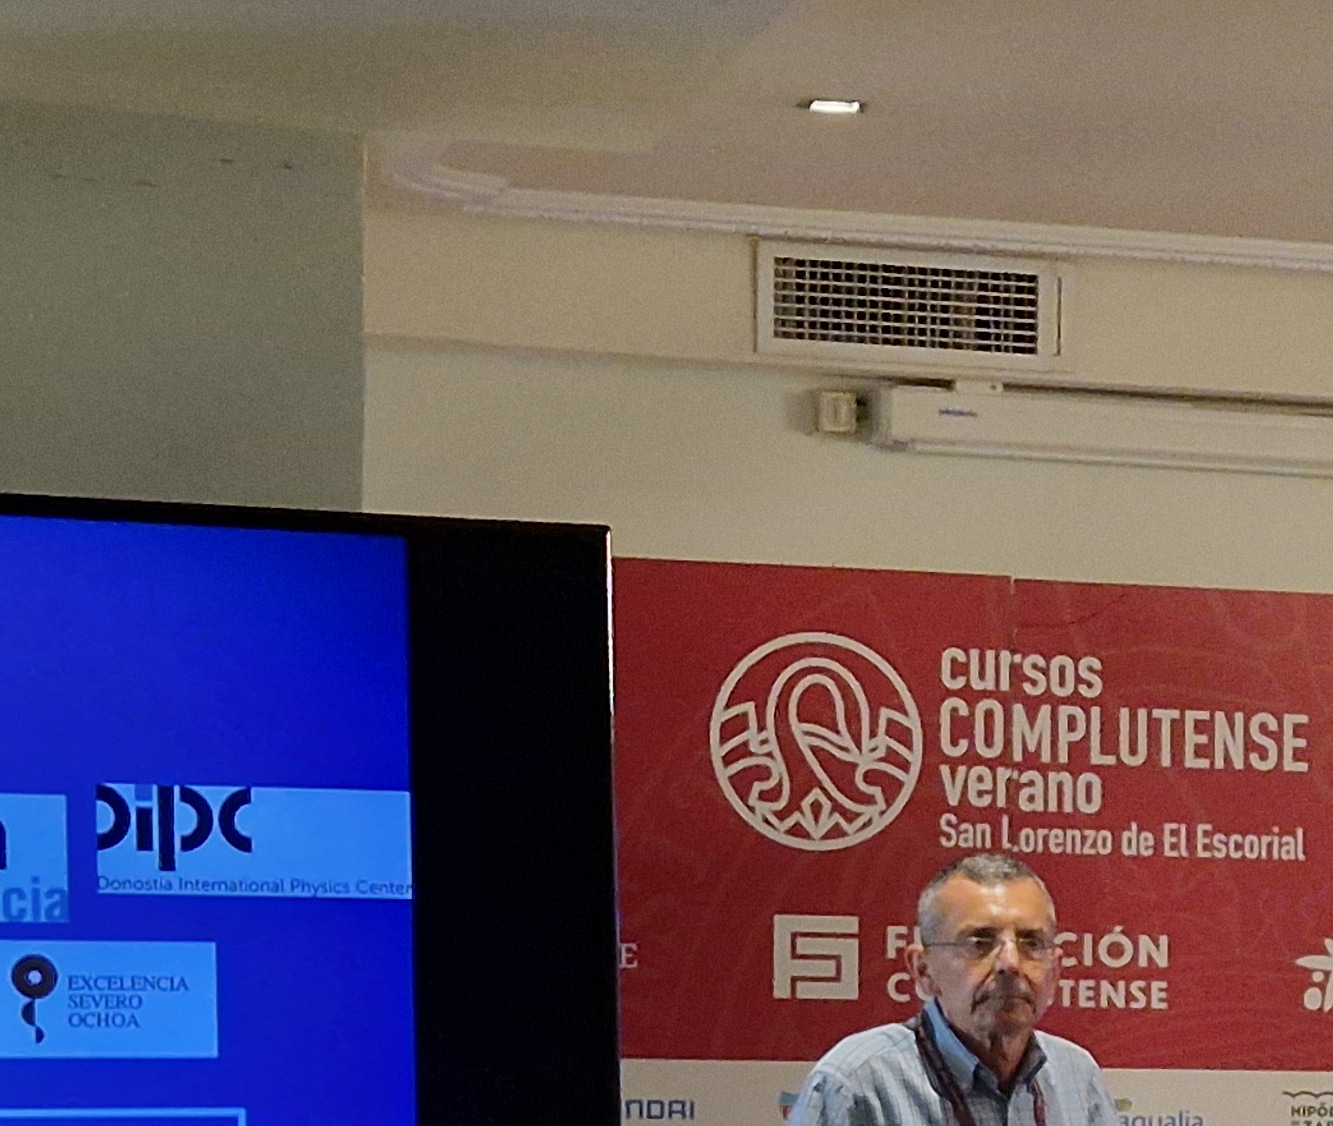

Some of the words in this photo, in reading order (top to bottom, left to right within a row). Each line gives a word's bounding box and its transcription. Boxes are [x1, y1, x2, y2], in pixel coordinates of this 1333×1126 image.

[940, 647, 1102, 698] cursos
[939, 697, 1309, 772] COMPLUTENSE
[939, 764, 1101, 814] verano
[940, 813, 991, 849] San
[1002, 815, 1112, 855] Lorenzo
[1121, 821, 1154, 857] de
[1164, 823, 1189, 858] El
[1195, 824, 1306, 861] Escorial
[97, 876, 173, 891] Donostia
[179, 877, 284, 893] International
[291, 878, 350, 896] Physics
[356, 879, 413, 895] Center
[886, 925, 1169, 968] FCIÓN
[68, 975, 189, 992] EXCELENCIA
[68, 994, 142, 1009] SEVERO
[887, 972, 1169, 1009] CTENSE
[68, 1012, 140, 1028] OCHOA
[625, 1098, 695, 1121] NDAI
